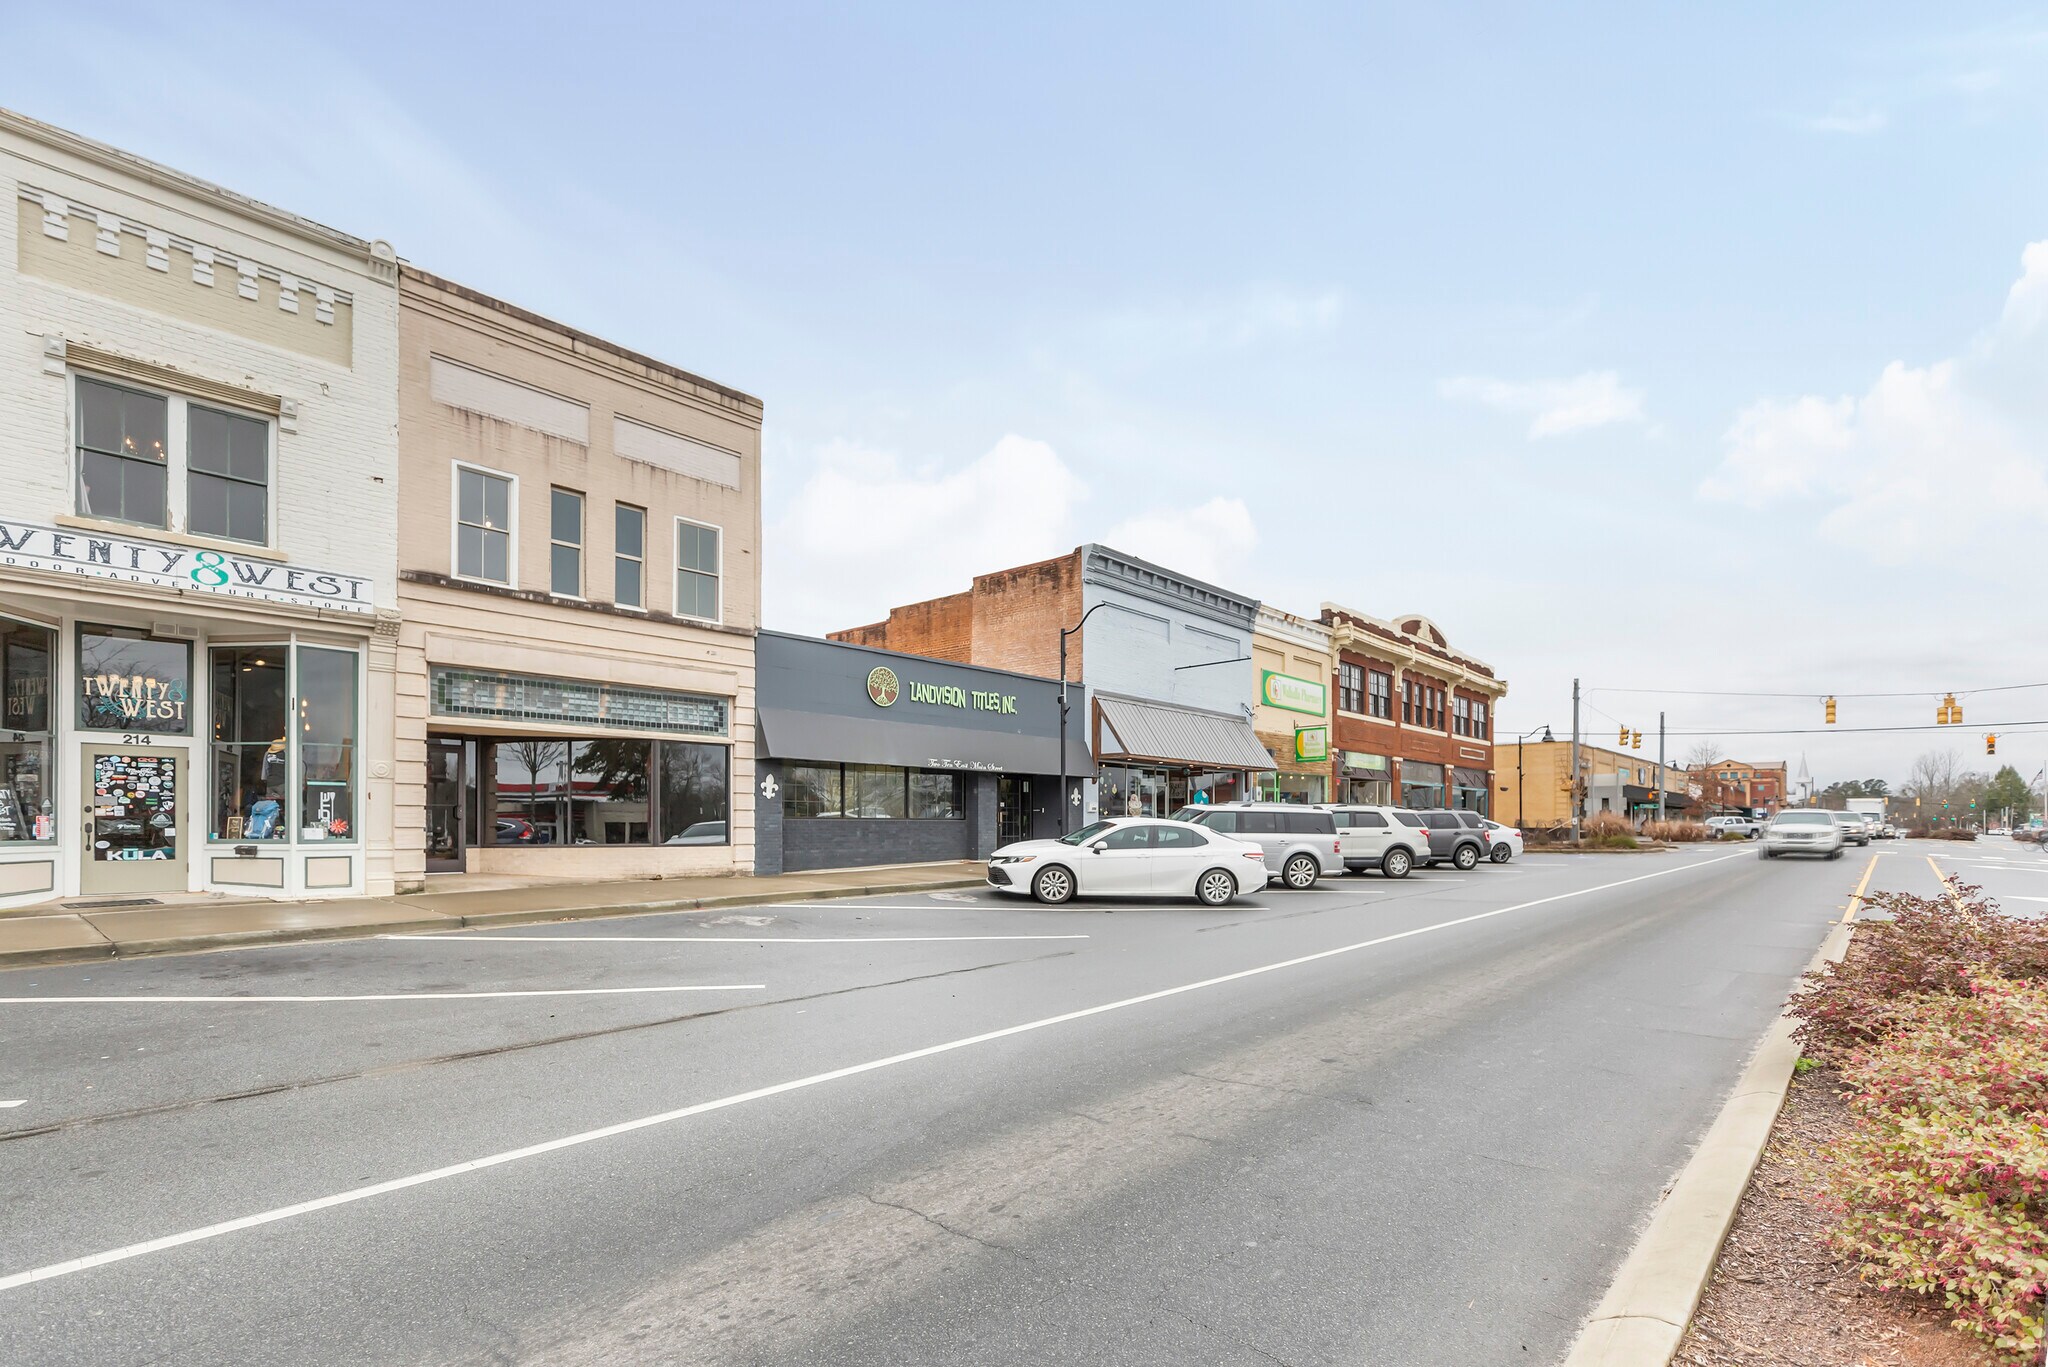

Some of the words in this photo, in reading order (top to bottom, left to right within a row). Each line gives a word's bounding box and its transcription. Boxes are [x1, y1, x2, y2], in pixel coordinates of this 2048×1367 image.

[110, 572, 270, 600] ADVENTURE
[191, 551, 229, 586] 8
[229, 561, 364, 600] WEST
[83, 675, 169, 700] TWENTY
[168, 678, 187, 701] 8
[910, 681, 967, 708] LANDVISION
[119, 697, 185, 720] WEST
[123, 735, 151, 745] 214
